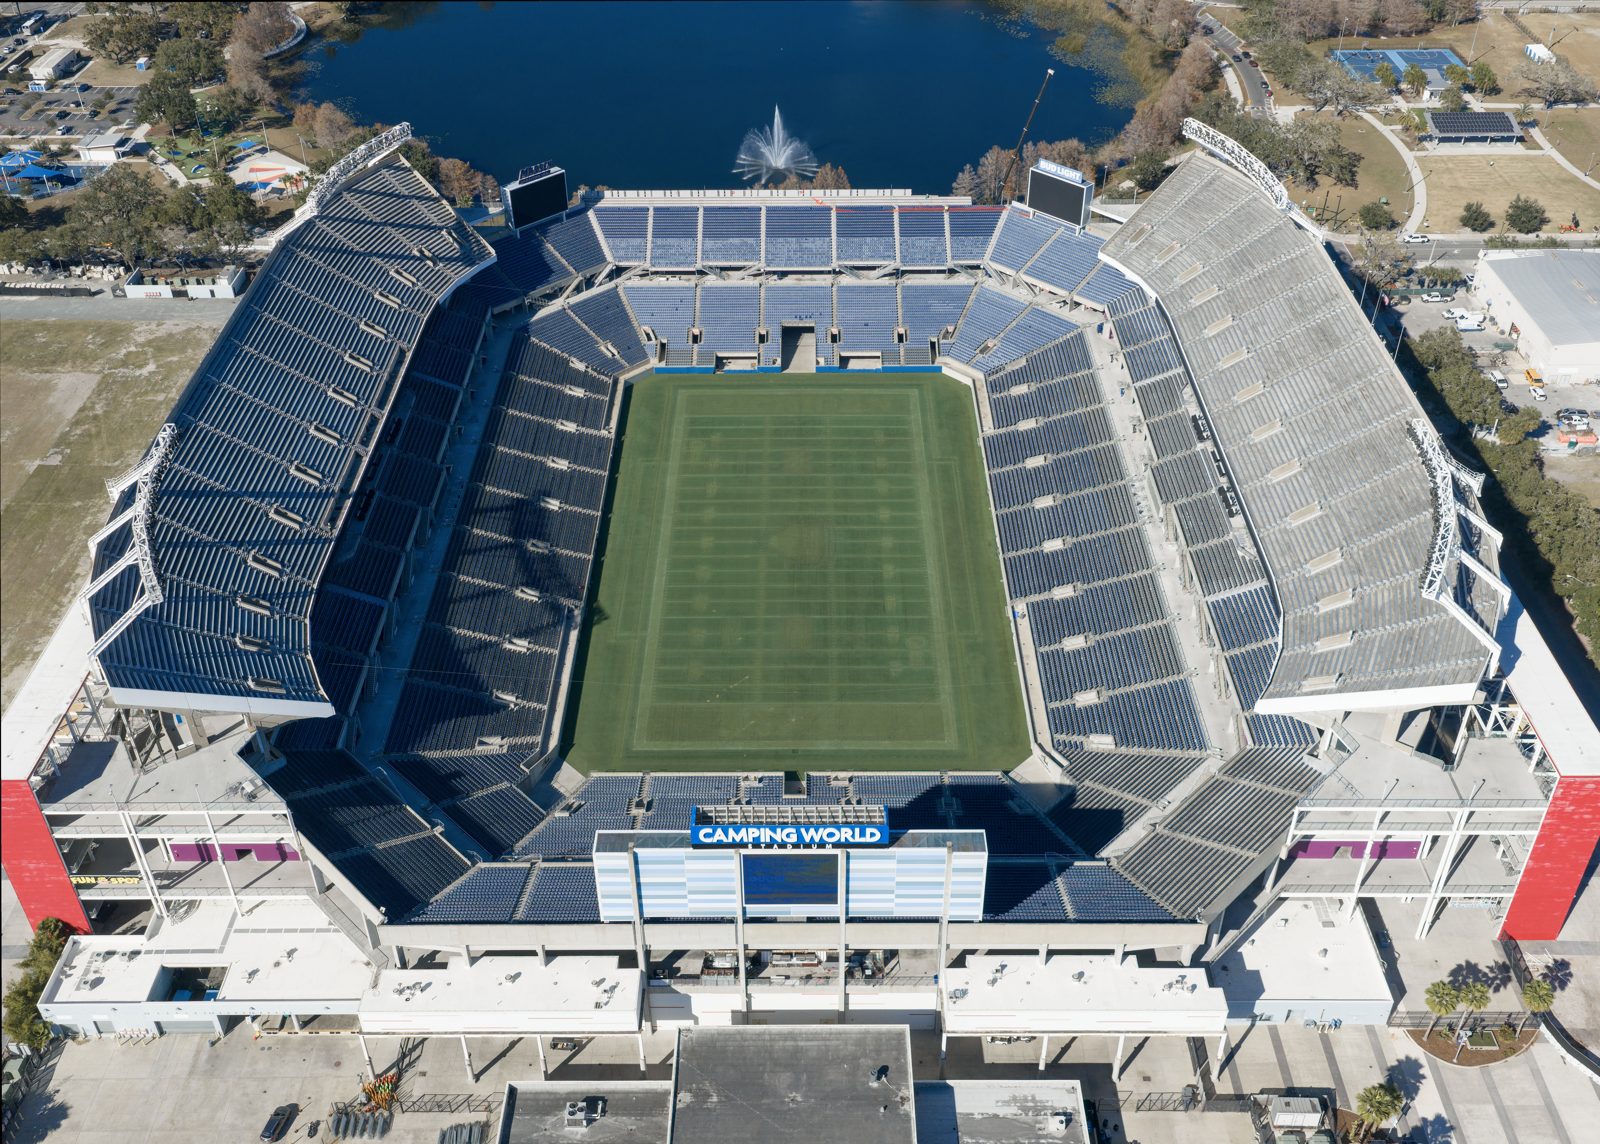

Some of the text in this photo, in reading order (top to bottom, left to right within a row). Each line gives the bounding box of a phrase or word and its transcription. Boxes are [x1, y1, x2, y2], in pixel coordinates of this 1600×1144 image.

[698, 827, 882, 843] CAMPING WORLD
[70, 876, 96, 884] FUN
